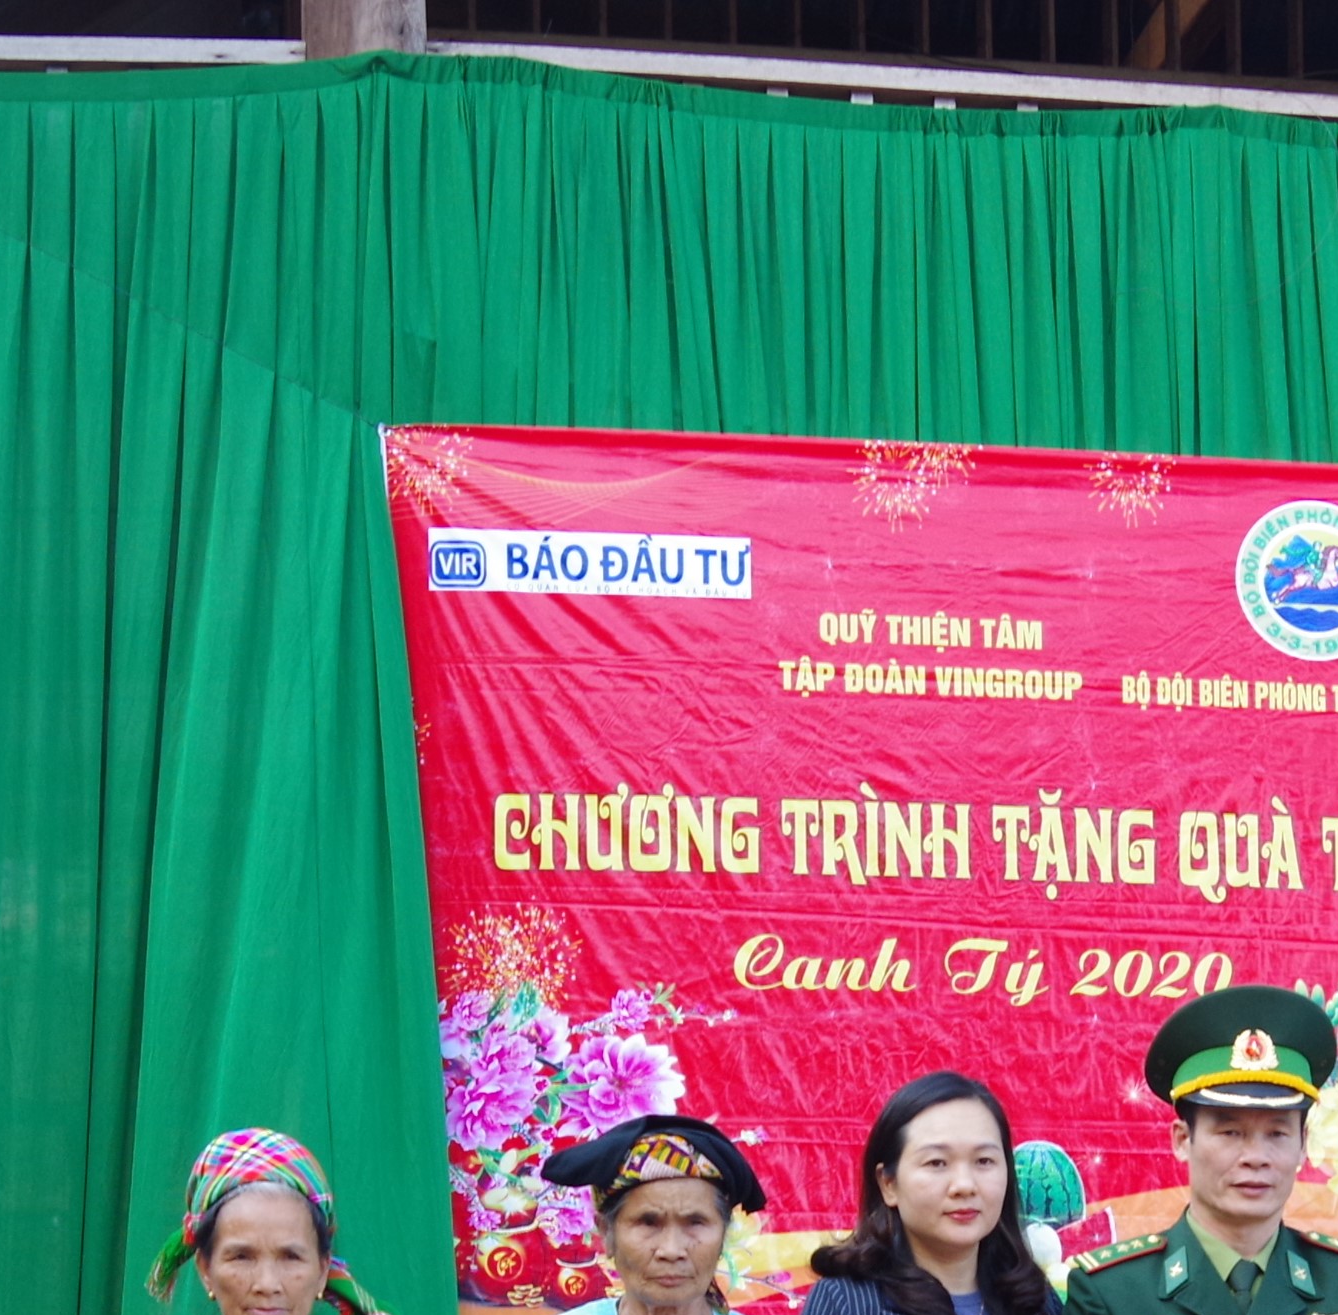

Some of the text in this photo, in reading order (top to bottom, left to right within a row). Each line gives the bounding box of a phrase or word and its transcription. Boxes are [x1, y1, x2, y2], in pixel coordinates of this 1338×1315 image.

[437, 551, 479, 578] VIR
[506, 534, 752, 587] BÁO ĐẦU TƯ
[819, 608, 1043, 653] QUỸ THIỆN TÂM
[778, 655, 1083, 701] TẬP ĐOÀN VINGROUP
[1122, 670, 1150, 710] BỘ
[1156, 672, 1192, 712] ĐỘI
[1199, 674, 1248, 709] BIÊN
[1254, 675, 1326, 712] PHÒNG
[493, 781, 761, 874] CHƯƠNG
[780, 780, 972, 885] TRÌNH
[991, 787, 1157, 901] TẶNG
[1178, 795, 1305, 904] QUÀ
[732, 932, 1235, 1007] Canh Tý 2020
